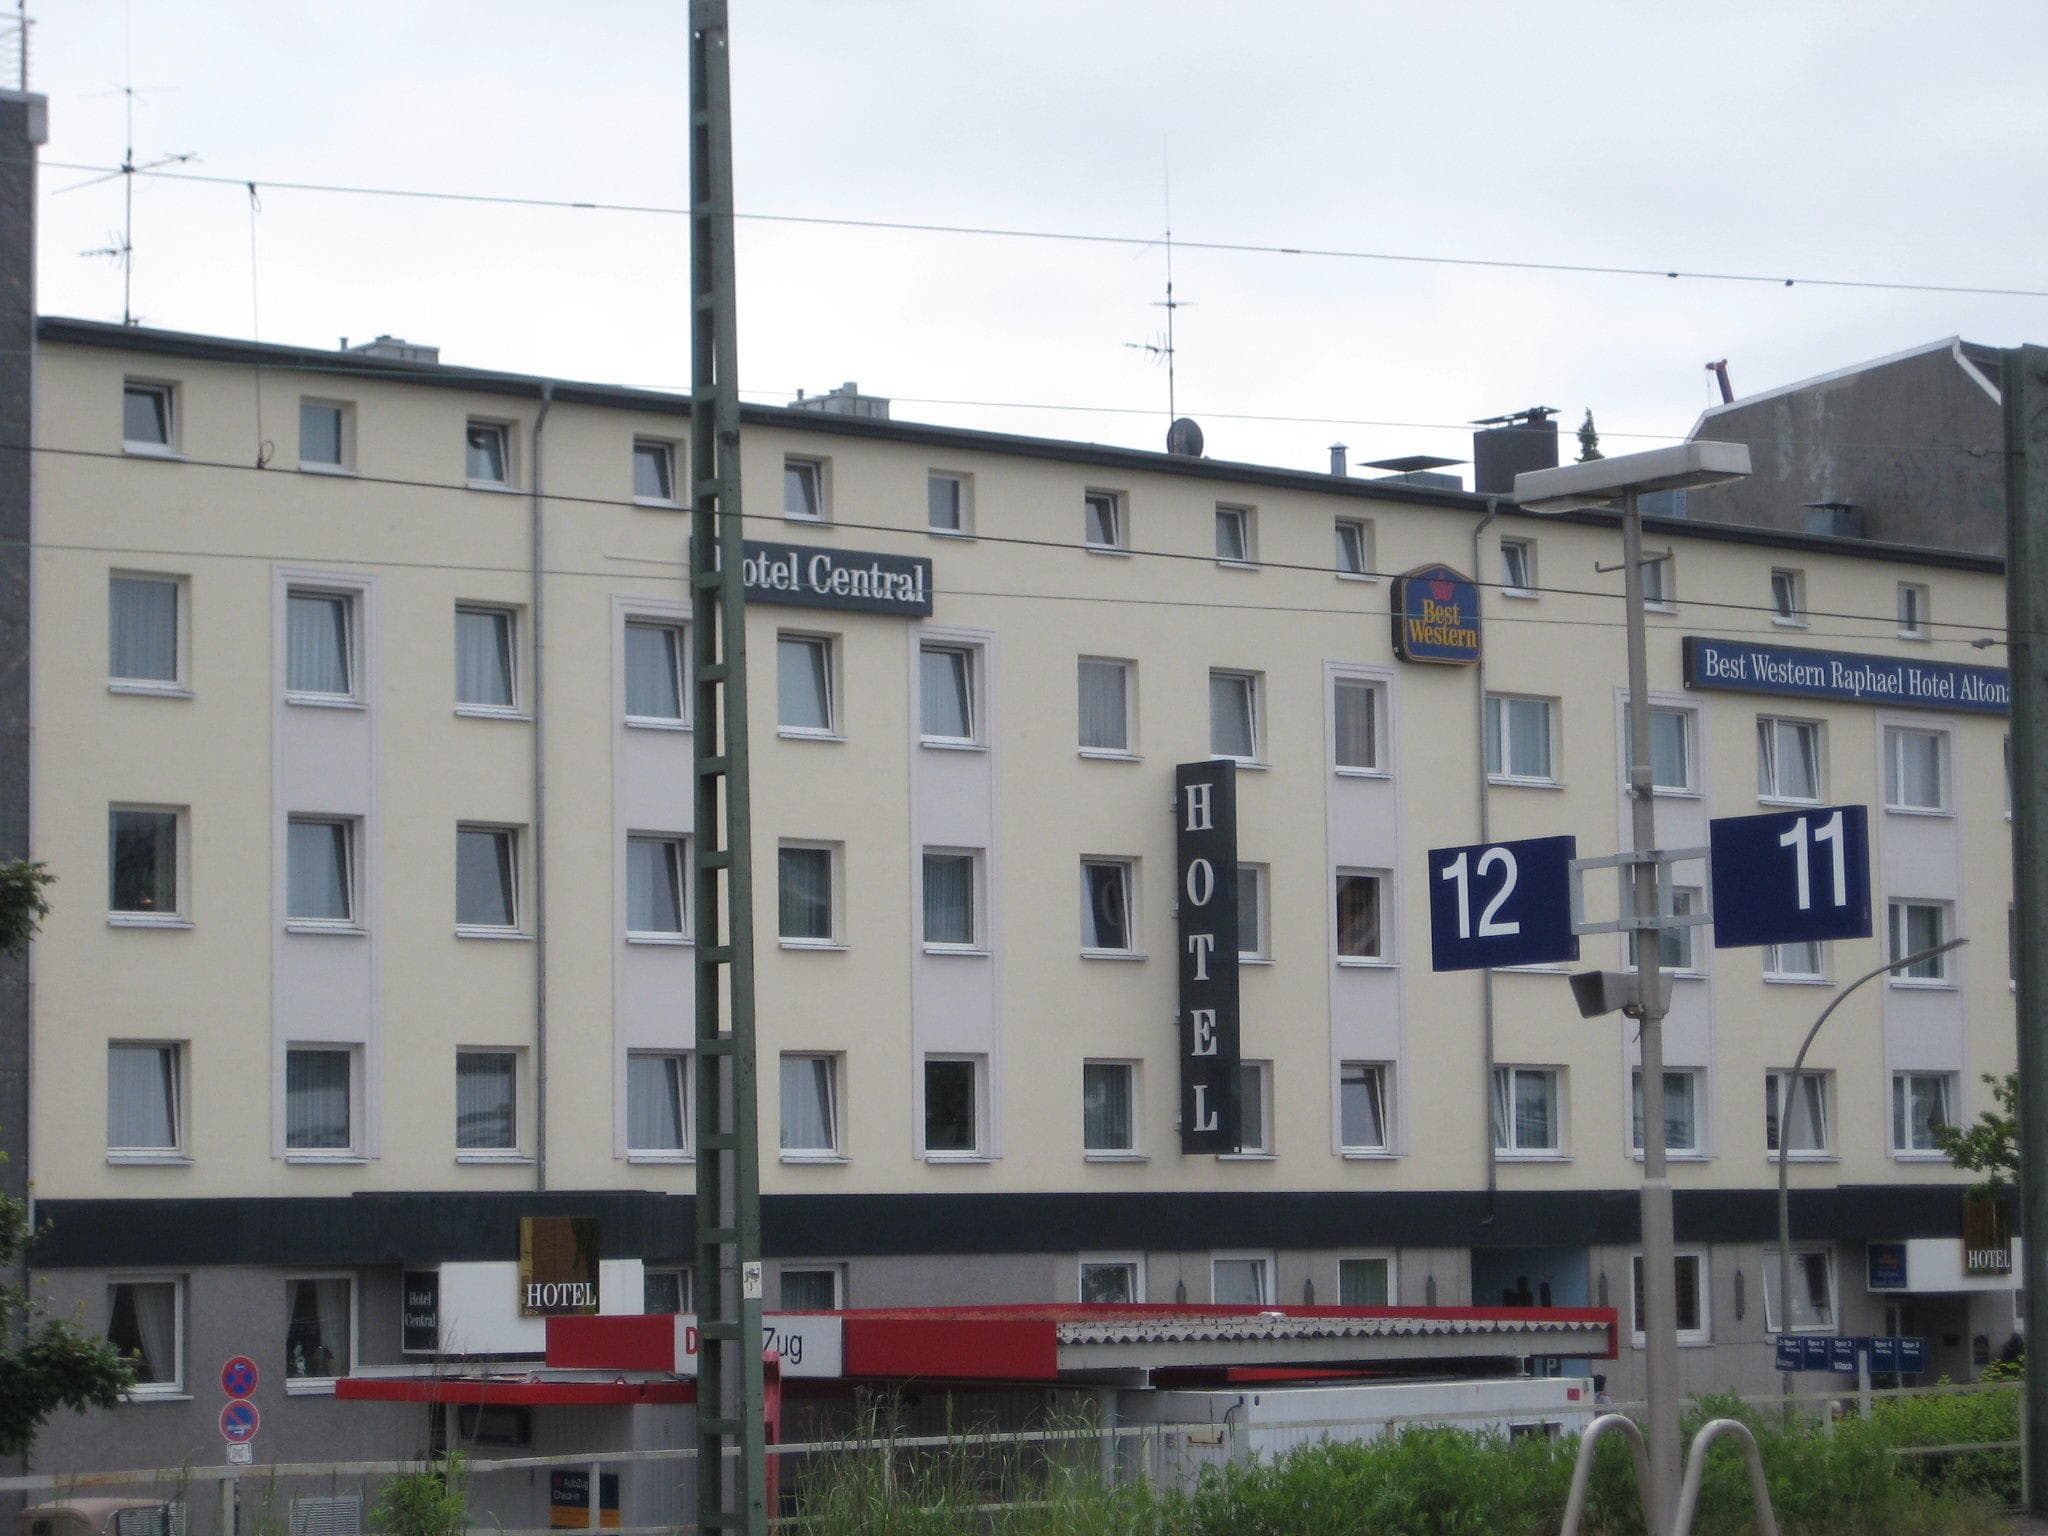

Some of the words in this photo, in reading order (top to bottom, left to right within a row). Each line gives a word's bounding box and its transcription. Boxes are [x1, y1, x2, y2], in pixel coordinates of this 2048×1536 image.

[740, 550, 800, 592] otel
[808, 554, 926, 604] Central
[1423, 598, 1461, 626] Best
[1408, 618, 1479, 649] Western
[1704, 648, 1747, 679] Best
[1749, 653, 1826, 687] Western
[1831, 661, 1904, 697] Raphael
[1908, 668, 1955, 700] Hotel
[1779, 811, 1847, 910] 11
[1442, 846, 1520, 939] 12
[1184, 782, 1218, 1132] HOTEL
[1968, 1249, 2012, 1269] HOTEL
[409, 1291, 432, 1306] Hotel
[527, 1282, 597, 1308] HOTEL
[404, 1312, 436, 1329] Central
